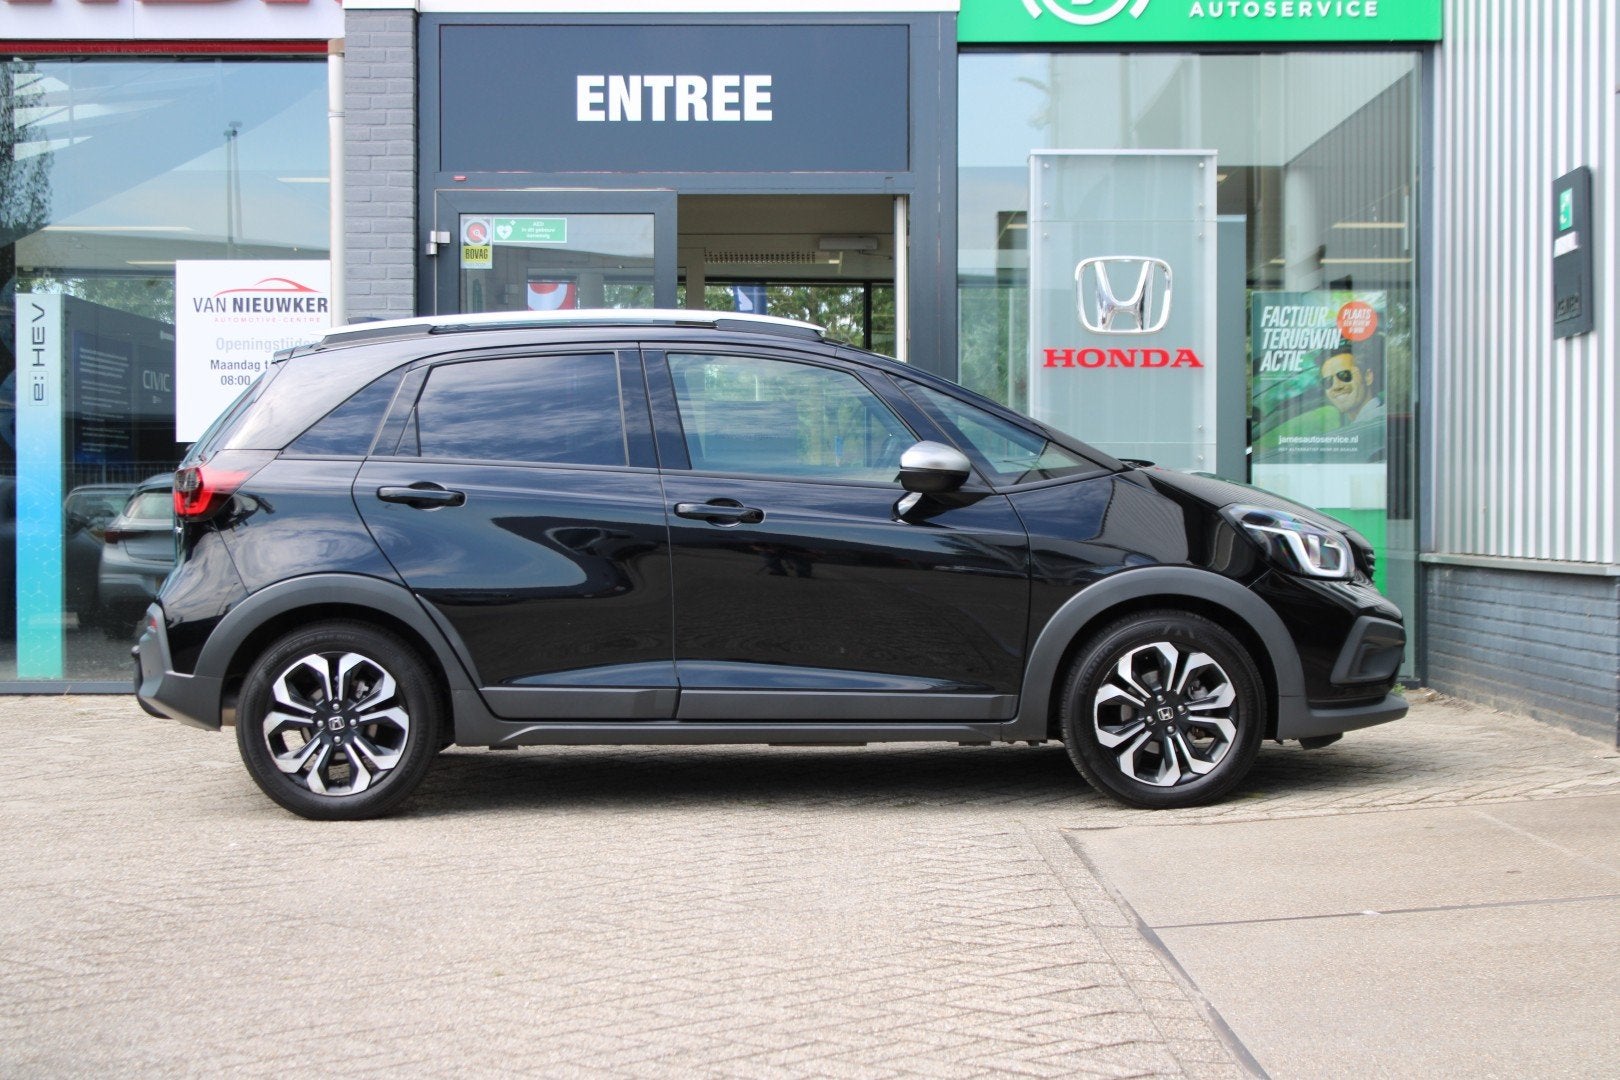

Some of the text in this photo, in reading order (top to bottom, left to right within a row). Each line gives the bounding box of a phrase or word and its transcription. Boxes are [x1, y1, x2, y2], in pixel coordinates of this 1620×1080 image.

[1189, 0, 1378, 18] AUTOSERVICE
[576, 74, 773, 122] ENTREE
[465, 248, 489, 260] BOVAG
[193, 297, 329, 313] VAN NIEUWKER
[1260, 305, 1329, 328] FACTUUR
[1262, 328, 1342, 350] TERUGWIN
[210, 359, 261, 372] Maandag
[1043, 348, 1204, 368] HONDA
[1260, 350, 1307, 372] ACTIE
[143, 370, 171, 393] CIVIC
[220, 375, 251, 386] 08:00
[1278, 435, 1359, 445] jamesautoservice.nl
